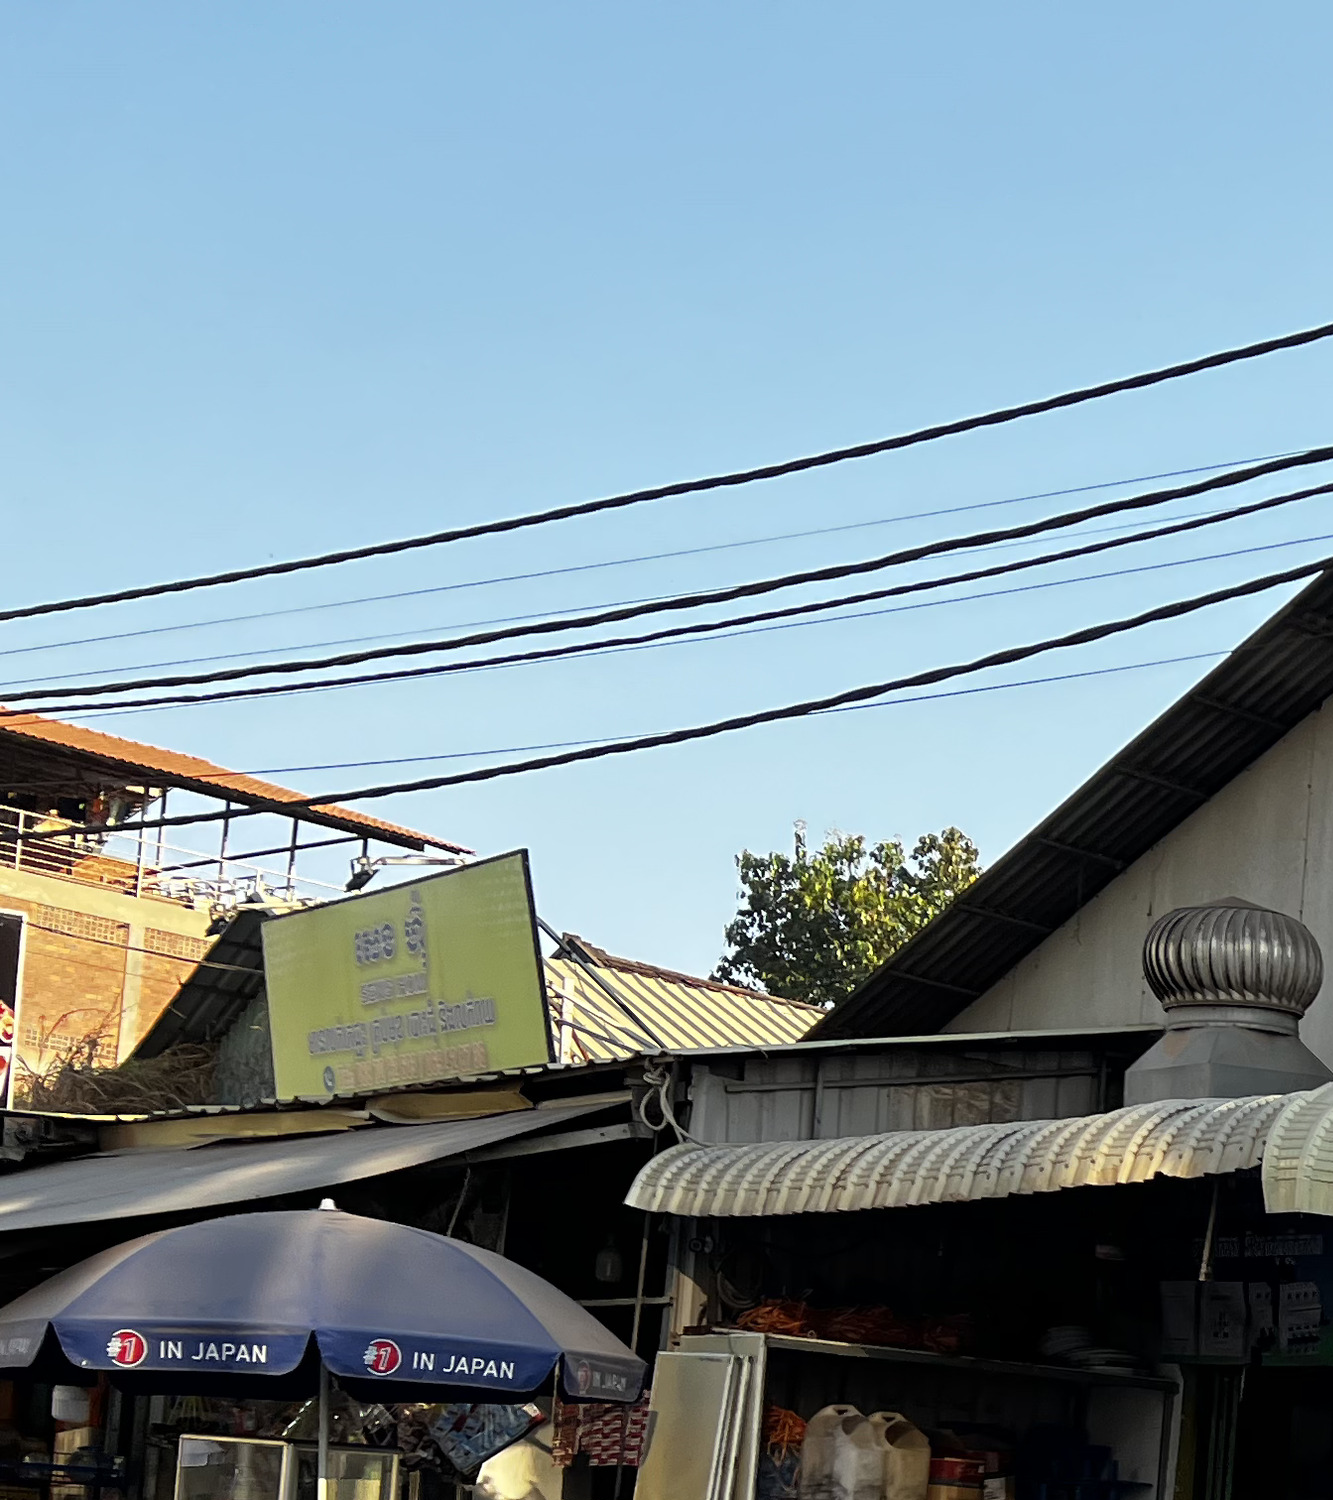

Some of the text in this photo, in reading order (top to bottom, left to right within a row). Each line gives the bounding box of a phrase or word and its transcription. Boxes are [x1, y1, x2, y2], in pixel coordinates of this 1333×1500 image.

[159, 1340, 183, 1359] IN
[190, 1342, 268, 1364] JAPAN
[412, 1351, 436, 1371] IN
[442, 1355, 515, 1380] JAPAN
